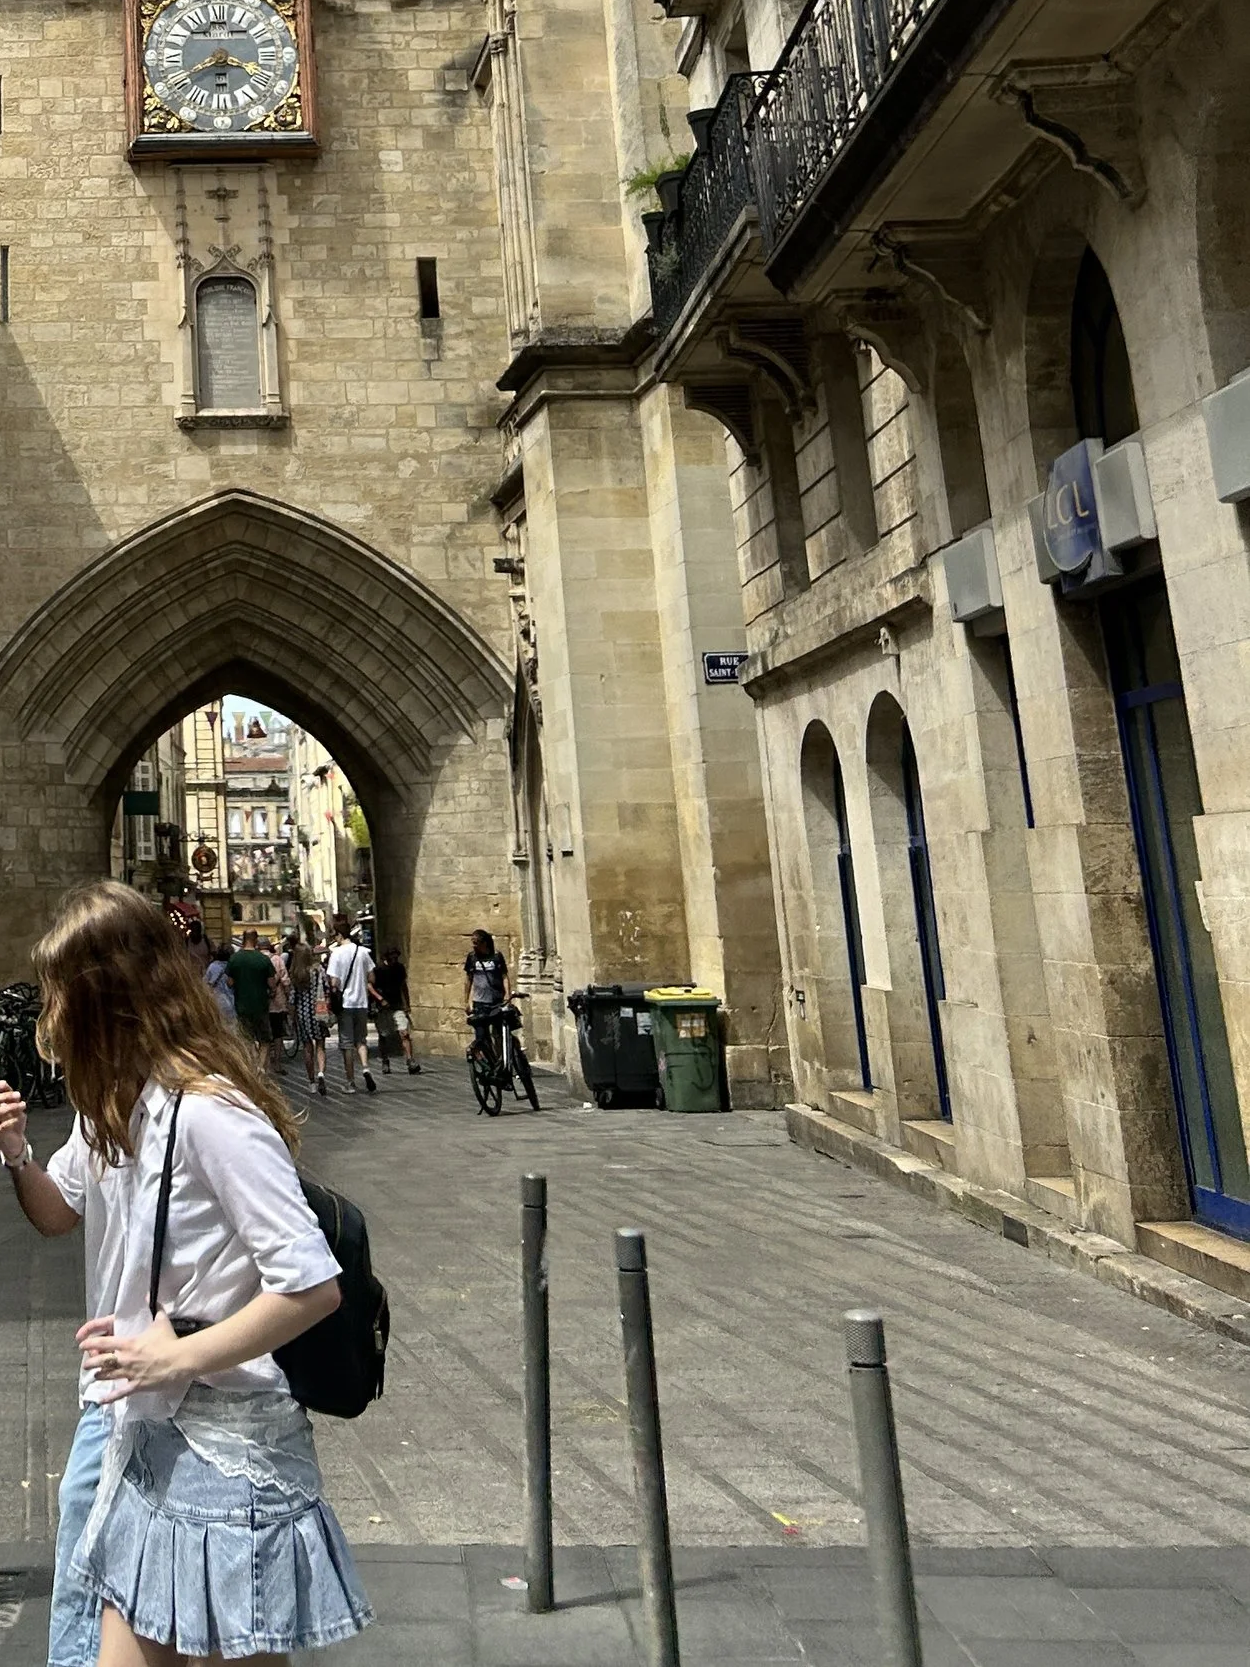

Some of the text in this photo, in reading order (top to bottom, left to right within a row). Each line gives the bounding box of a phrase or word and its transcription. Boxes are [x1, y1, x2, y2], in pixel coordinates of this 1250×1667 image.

[210, 4, 226, 20] XII
[251, 27, 269, 40] II
[259, 50, 276, 65] III
[188, 87, 206, 106] VII
[1047, 481, 1089, 529] LCL
[720, 657, 739, 666] RUE
